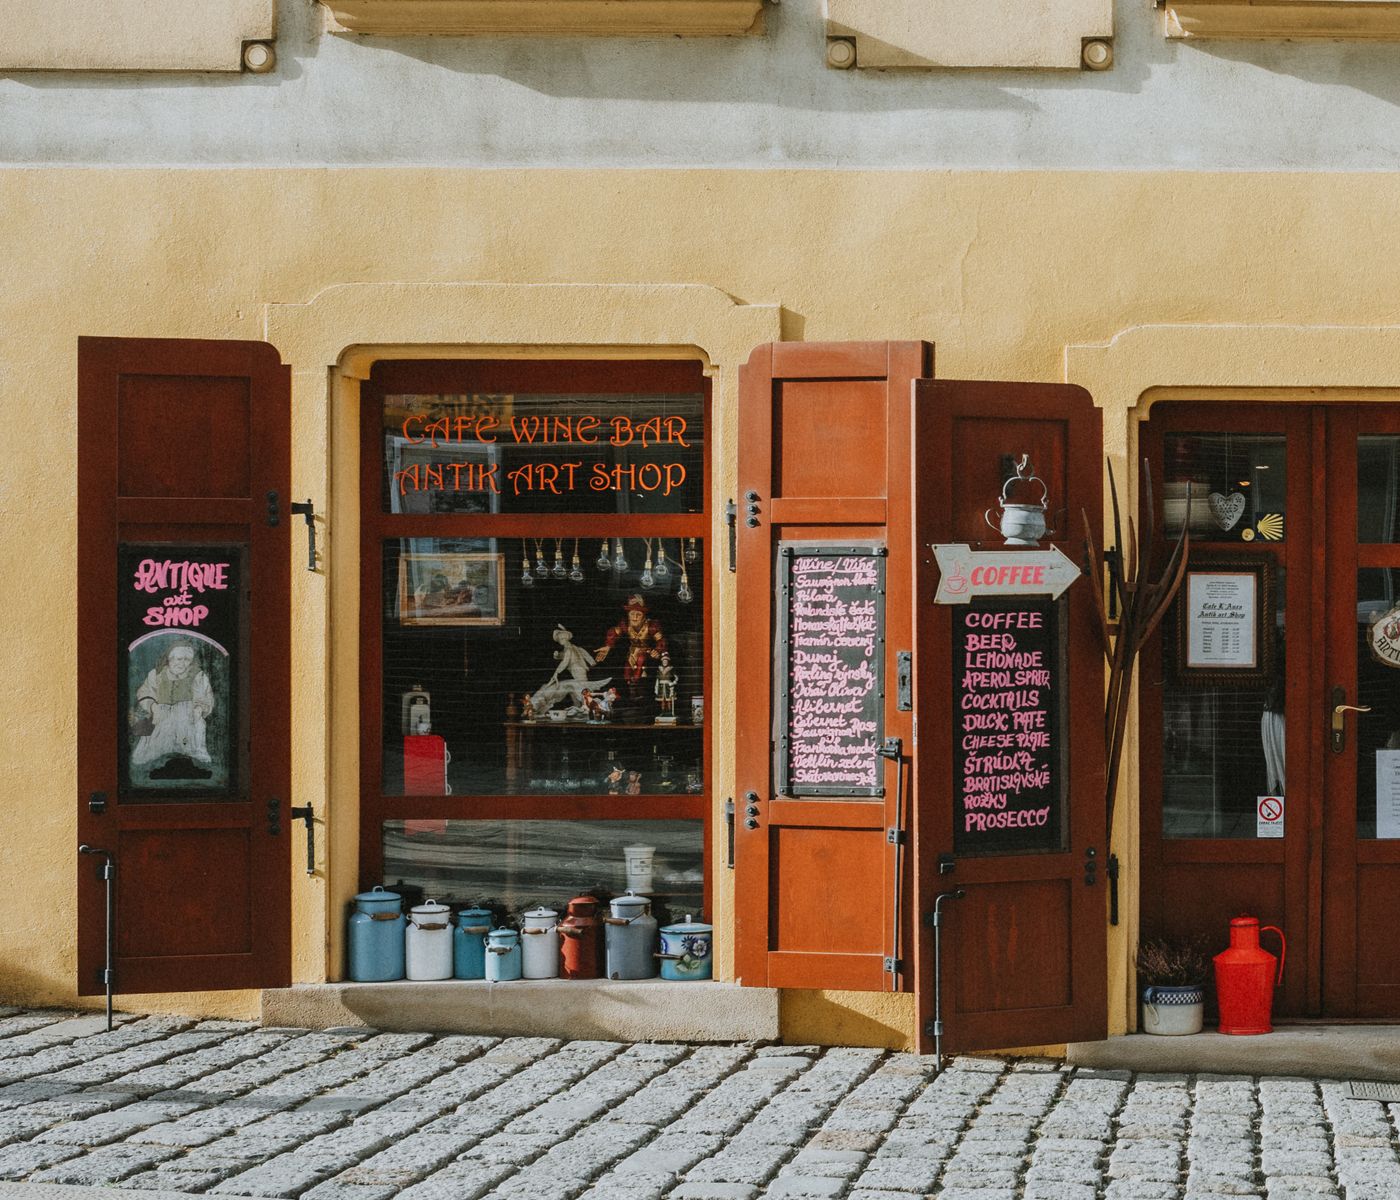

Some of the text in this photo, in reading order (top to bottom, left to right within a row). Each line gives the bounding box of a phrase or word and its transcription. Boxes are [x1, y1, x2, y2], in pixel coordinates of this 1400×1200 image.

[402, 415, 690, 448] CAFE WINE BAR
[395, 462, 686, 496] ANTIK ART SHOP
[133, 558, 230, 593] ANTIQUE
[970, 566, 1046, 586] COFFEE
[163, 590, 193, 606] art
[142, 605, 209, 626] SHOP
[965, 612, 1042, 629] COFFEE
[964, 633, 1017, 652] BEER
[793, 649, 842, 671] Dunaj
[965, 651, 1043, 669] LEMONADE
[962, 670, 1015, 692] APEROL
[961, 690, 1039, 710] COCKTAILS
[962, 711, 1046, 733] DUCK PATE
[962, 732, 1050, 751] CHEESE PLATE
[964, 806, 1049, 832] PROSECCO
